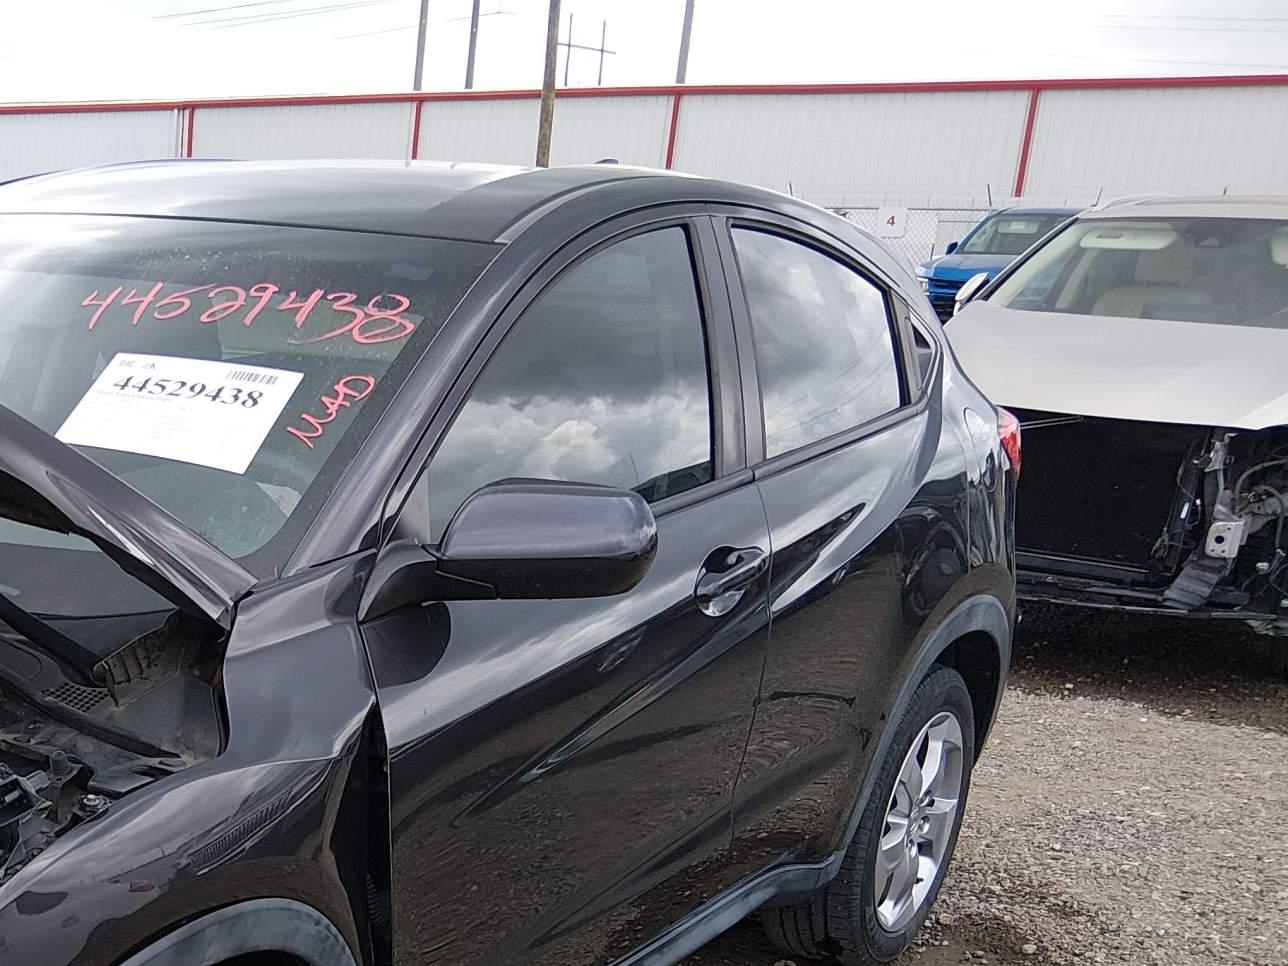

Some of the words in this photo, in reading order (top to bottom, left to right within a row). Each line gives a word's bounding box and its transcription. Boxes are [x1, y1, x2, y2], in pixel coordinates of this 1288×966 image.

[886, 215, 896, 227] 4
[81, 281, 415, 345] 44529438
[113, 375, 264, 409] 44529438
